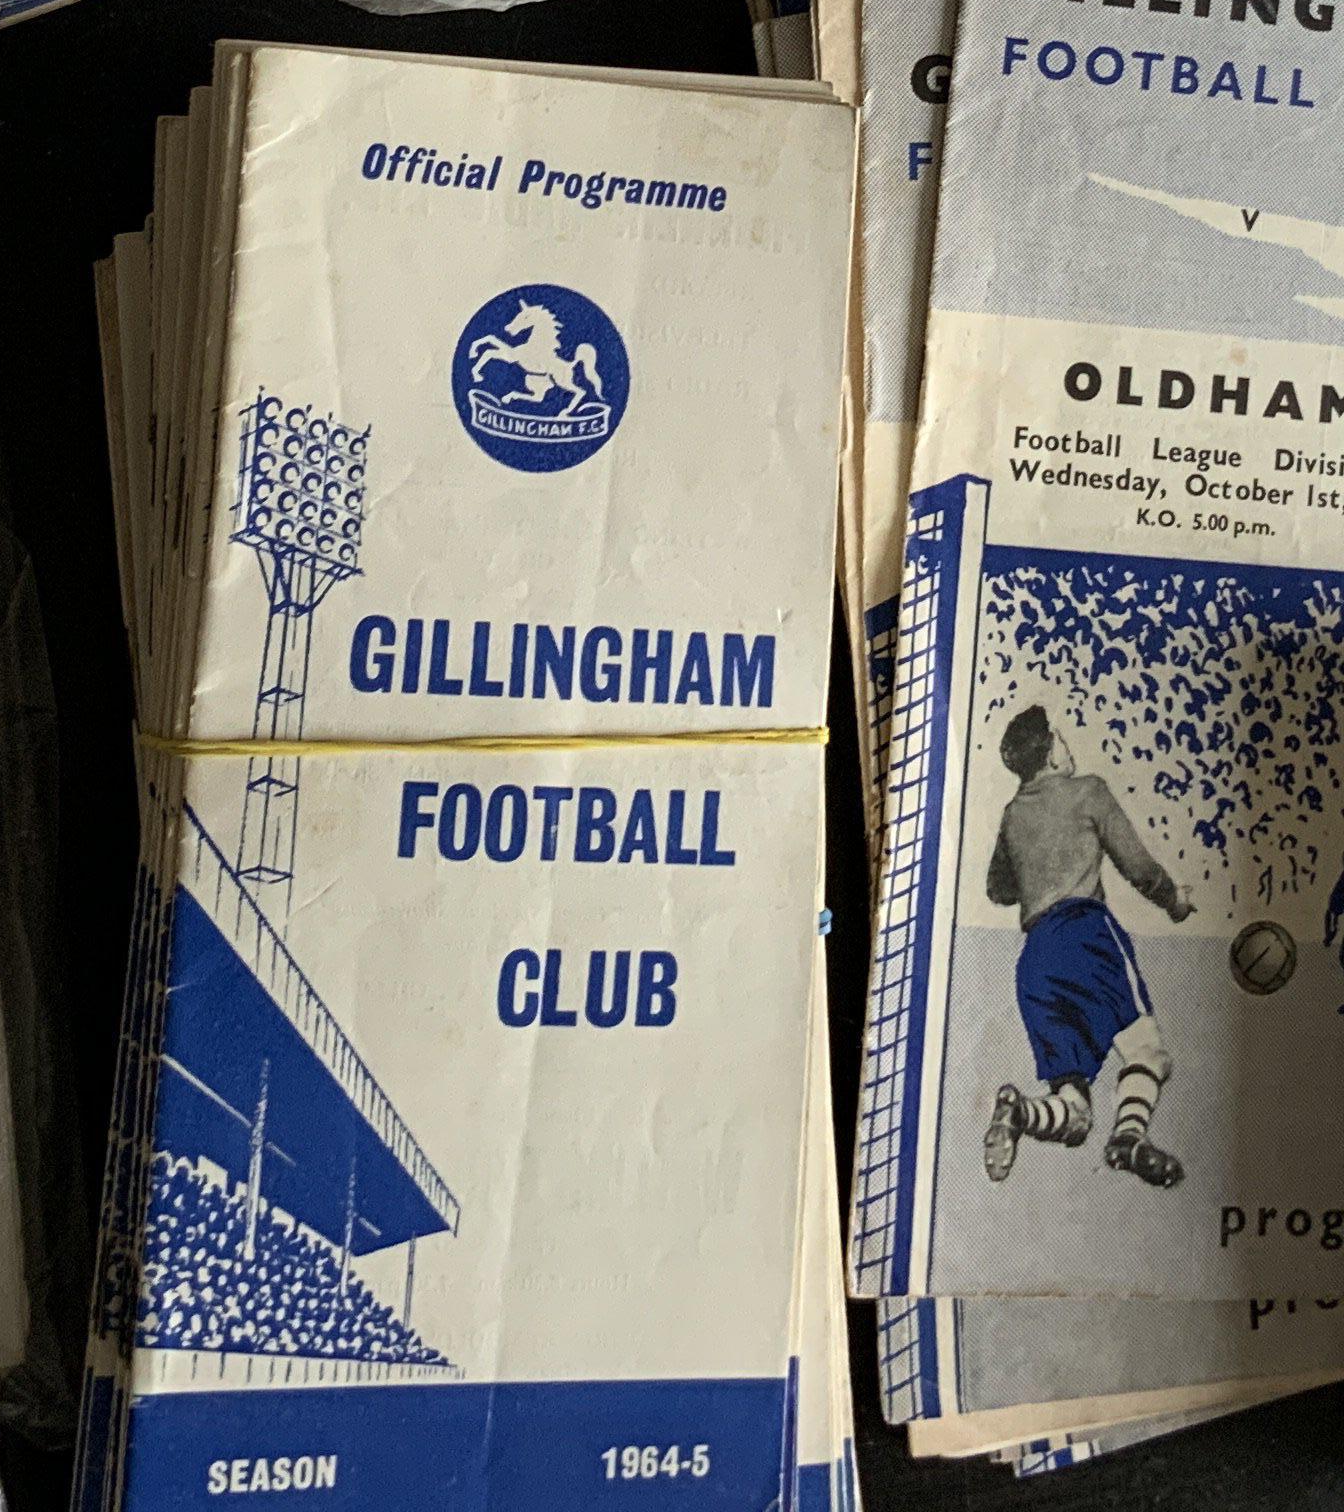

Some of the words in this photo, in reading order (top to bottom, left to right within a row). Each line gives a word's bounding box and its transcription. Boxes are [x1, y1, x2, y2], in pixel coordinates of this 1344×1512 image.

[1001, 36, 1317, 110] FOOTBALL
[361, 142, 504, 191] Official
[517, 159, 728, 212] Programme
[1009, 459, 1168, 501] Wednesday,
[1185, 474, 1294, 508] October
[1013, 427, 1121, 458] Football
[1153, 437, 1243, 471] League
[1136, 508, 1182, 530] K.O.
[1192, 513, 1229, 532] 5.00
[1234, 519, 1277, 539] p.m.
[348, 614, 776, 708] GILLINGHAM
[397, 781, 737, 866] FOOTBALL
[497, 947, 679, 1028] CLUB
[206, 1454, 339, 1494] SEASON
[600, 1444, 712, 1481] 1964-5
